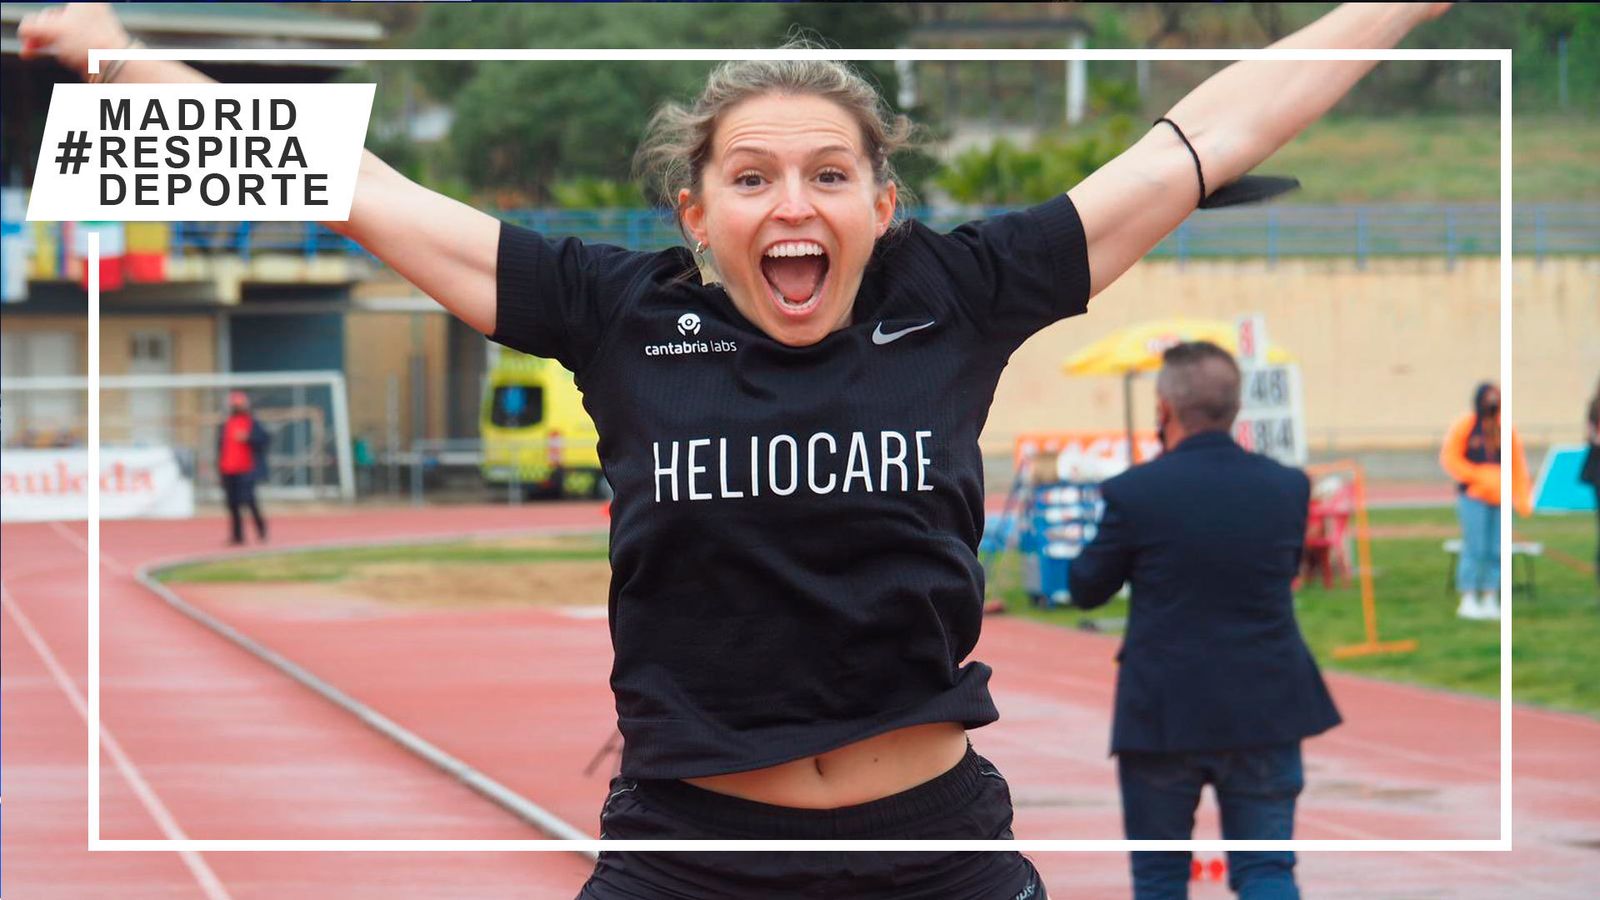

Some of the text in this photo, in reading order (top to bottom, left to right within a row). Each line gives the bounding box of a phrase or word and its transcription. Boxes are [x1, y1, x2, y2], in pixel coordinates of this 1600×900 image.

[644, 339, 738, 356] cantabria labs
[652, 430, 935, 503] HELIOCARE
